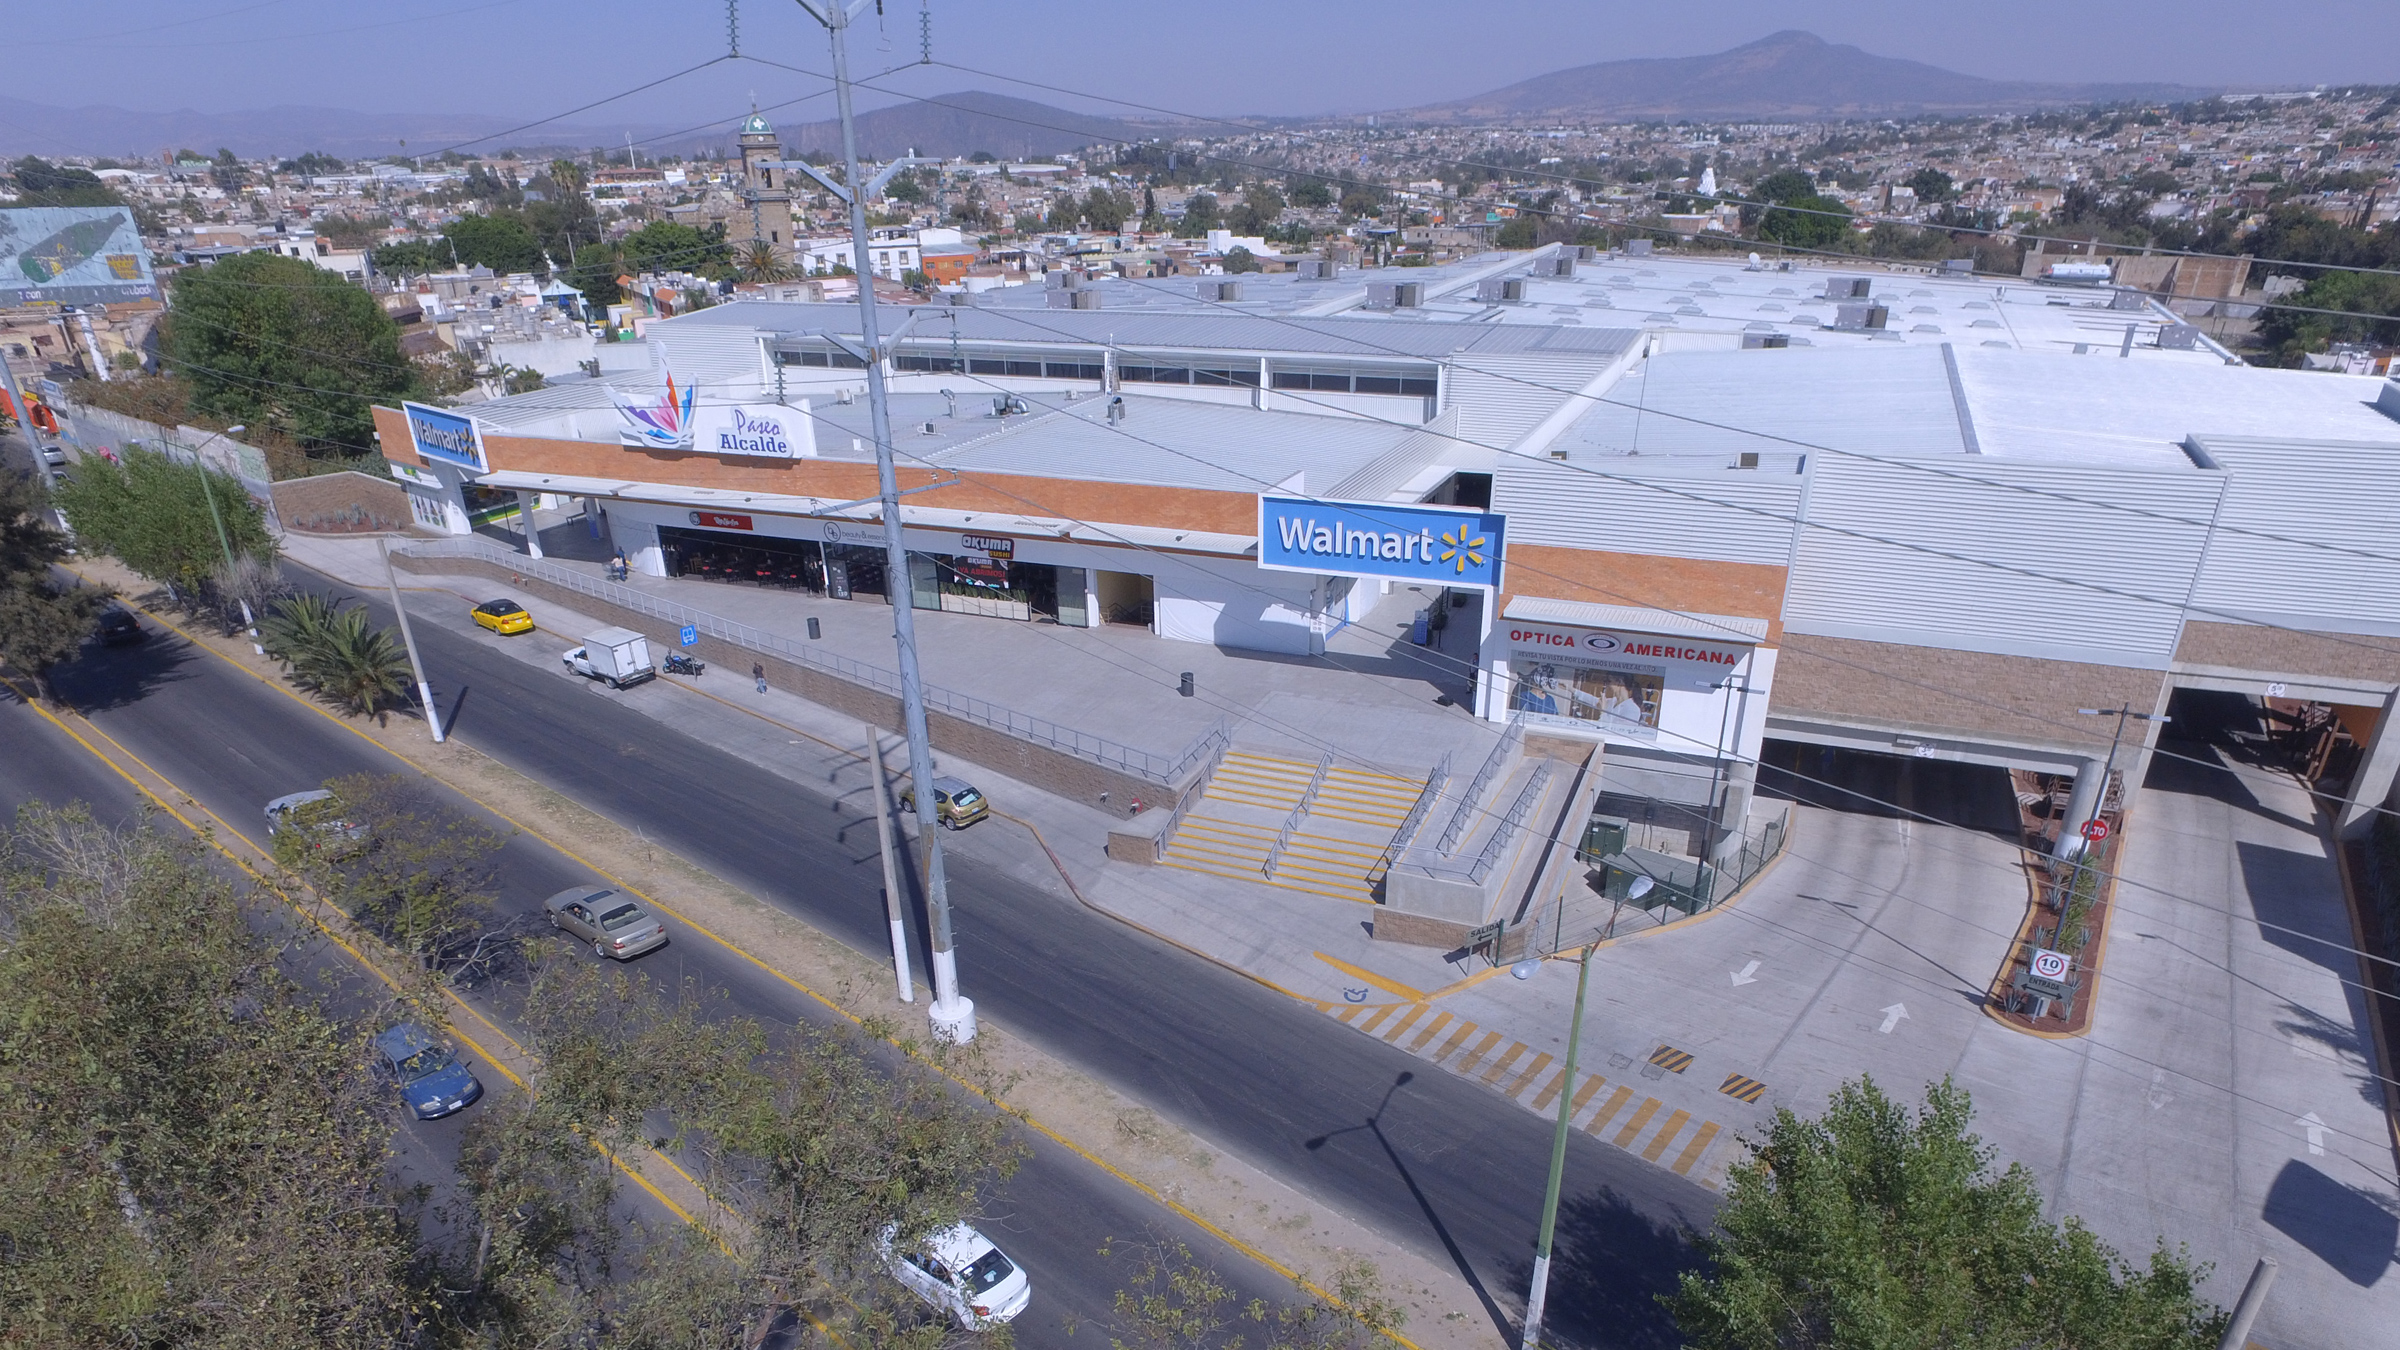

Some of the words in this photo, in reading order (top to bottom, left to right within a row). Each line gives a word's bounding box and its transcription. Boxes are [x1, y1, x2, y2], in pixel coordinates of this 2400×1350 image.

[734, 409, 780, 436] Paseo
[411, 417, 464, 456] Walmart
[720, 433, 787, 453] Alcalde
[962, 535, 1012, 551] OKUMA
[1278, 516, 1434, 564] Walmart
[1510, 629, 1575, 648] OPTICA
[1623, 642, 1736, 666] AMERICANA
[1517, 651, 1537, 659] REVISA
[1548, 654, 1564, 662] VISTA
[1470, 922, 1500, 938] SALIDA
[2041, 958, 2059, 969] 10
[2028, 977, 2060, 991] ENTRADA
